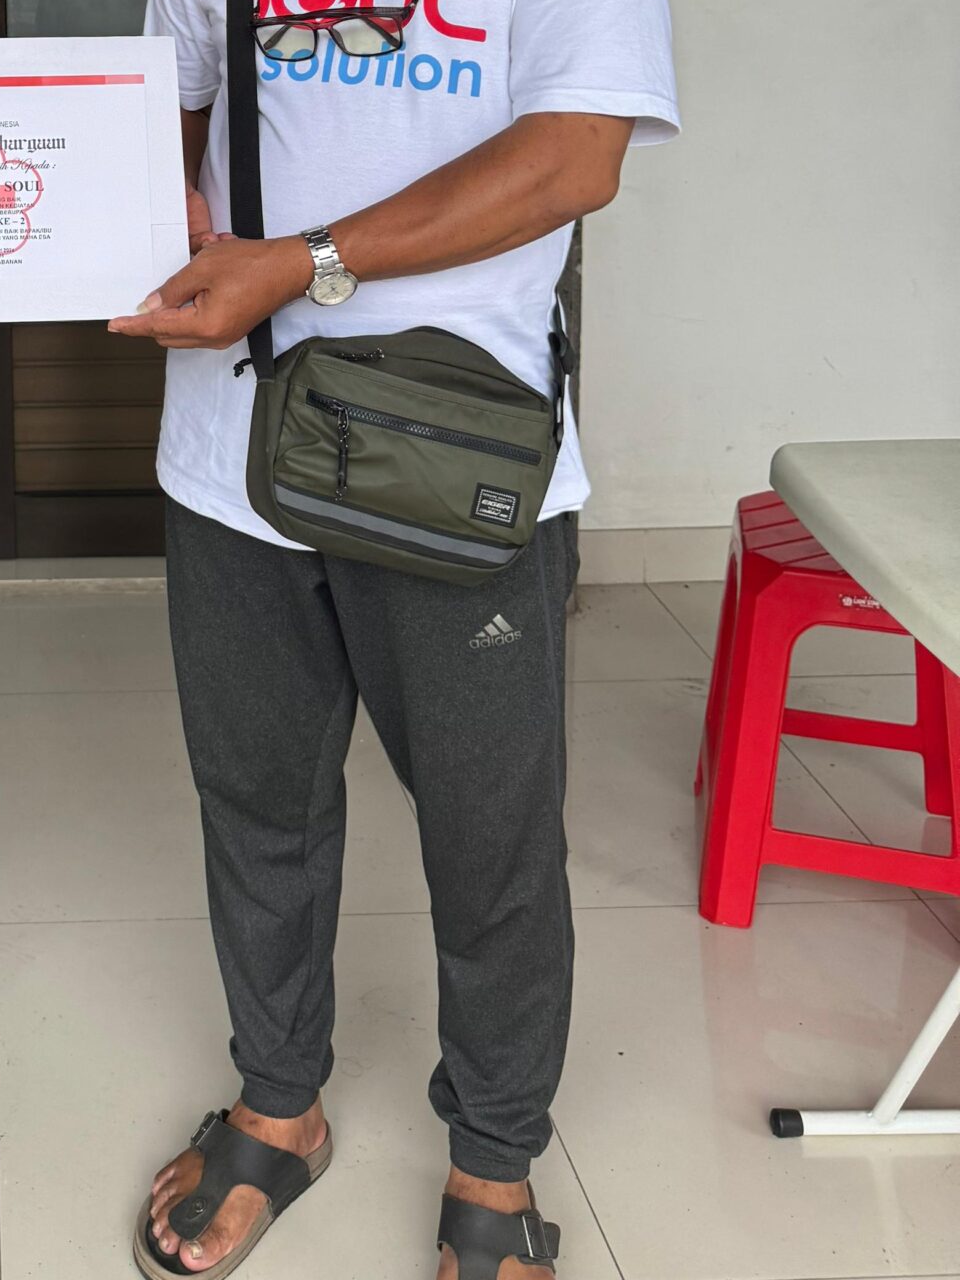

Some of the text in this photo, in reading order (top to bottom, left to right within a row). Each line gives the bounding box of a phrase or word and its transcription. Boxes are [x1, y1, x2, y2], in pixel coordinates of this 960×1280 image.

[259, 39, 482, 98] solution
[4, 180, 44, 192] SOUL
[20, 217, 25, 225] 2
[469, 629, 523, 649] adidas
